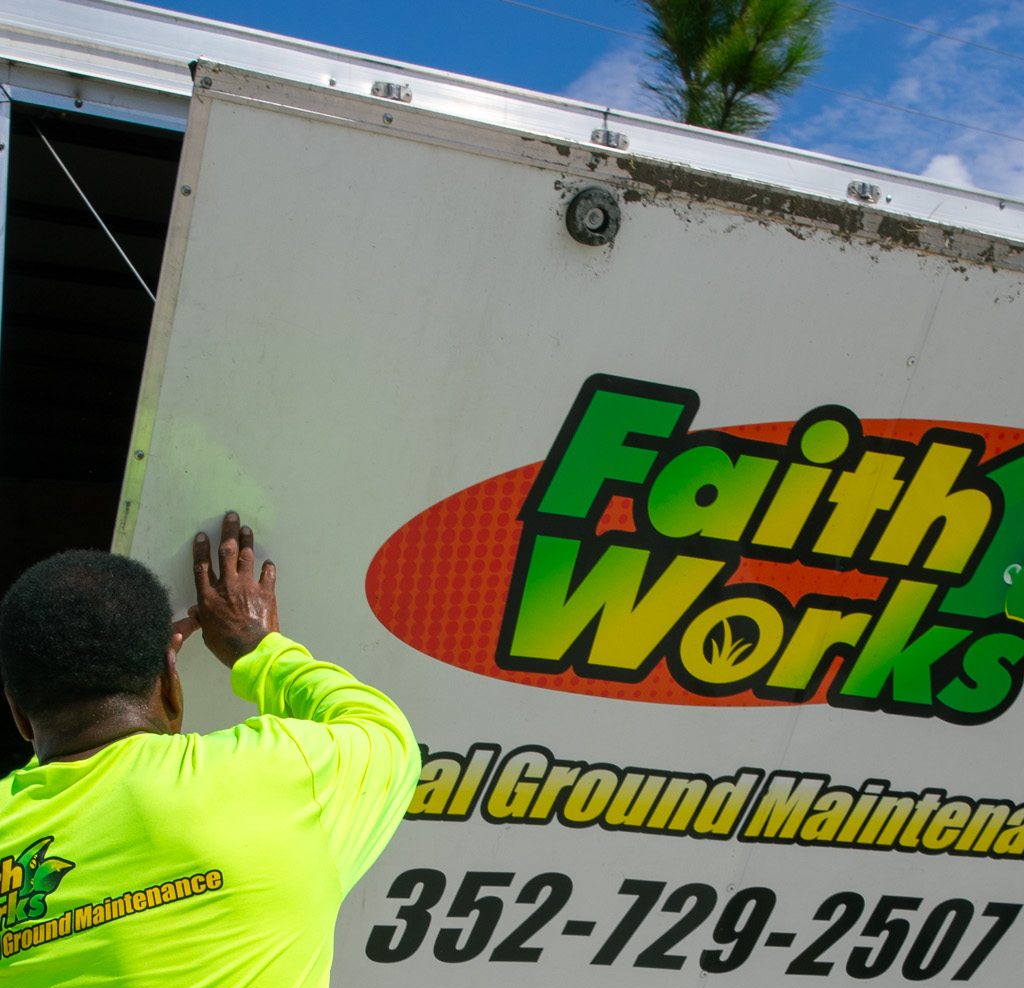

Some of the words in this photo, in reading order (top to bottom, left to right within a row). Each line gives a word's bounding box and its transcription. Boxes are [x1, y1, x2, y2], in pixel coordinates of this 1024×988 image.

[525, 378, 998, 583] Faith
[480, 744, 751, 844] Ground
[2, 910, 73, 958] Ground
[73, 869, 223, 933] Maintenance
[364, 867, 1024, 982] 352-729-2507
